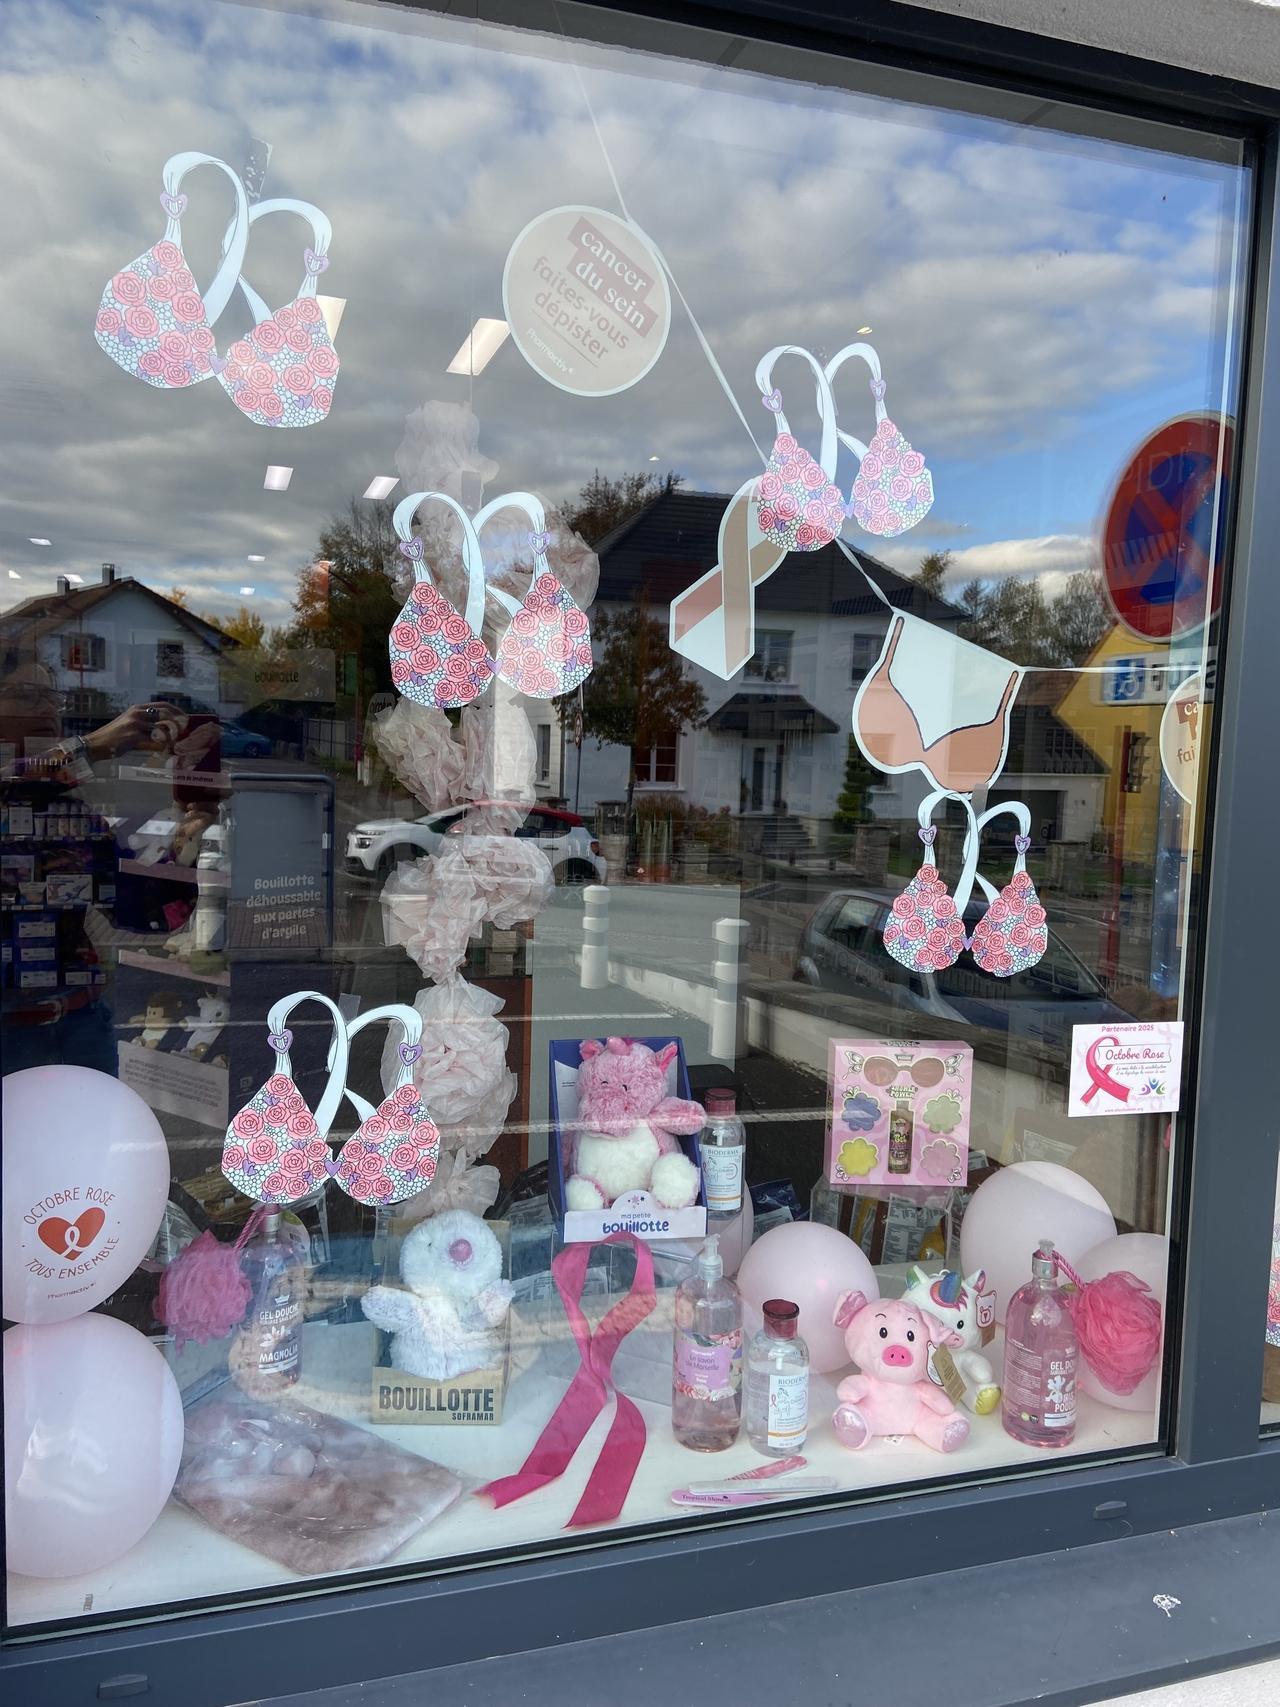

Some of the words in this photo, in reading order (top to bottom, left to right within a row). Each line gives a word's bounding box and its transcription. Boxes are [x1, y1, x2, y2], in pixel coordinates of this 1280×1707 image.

[581, 231, 647, 292] cancer
[532, 255, 629, 349] faites-vous
[575, 261, 604, 291] du
[603, 287, 645, 329] sein
[534, 290, 609, 359] dépister
[254, 874, 315, 890] Bouillotte
[246, 890, 321, 908] déhoussable
[253, 912, 276, 924] aux
[262, 924, 307, 940] d'argile
[1101, 1025, 1137, 1033] Partenaire
[1138, 1024, 1155, 1032] 2025
[1105, 1047, 1141, 1061] Octobre
[1142, 1047, 1165, 1059] Rose
[23, 1187, 81, 1225] OCTOBRE
[85, 1186, 116, 1207] ROSE
[632, 1212, 652, 1220] petite
[602, 1220, 670, 1234] bouillotte
[25, 1258, 56, 1279] TOUS
[58, 1237, 120, 1279] ENSEMBLE
[260, 1311, 273, 1321] GEL
[1050, 1361, 1064, 1370] GEL
[379, 1385, 494, 1412] BOUILLOTTE
[452, 1412, 494, 1421] SOFRAMAR
